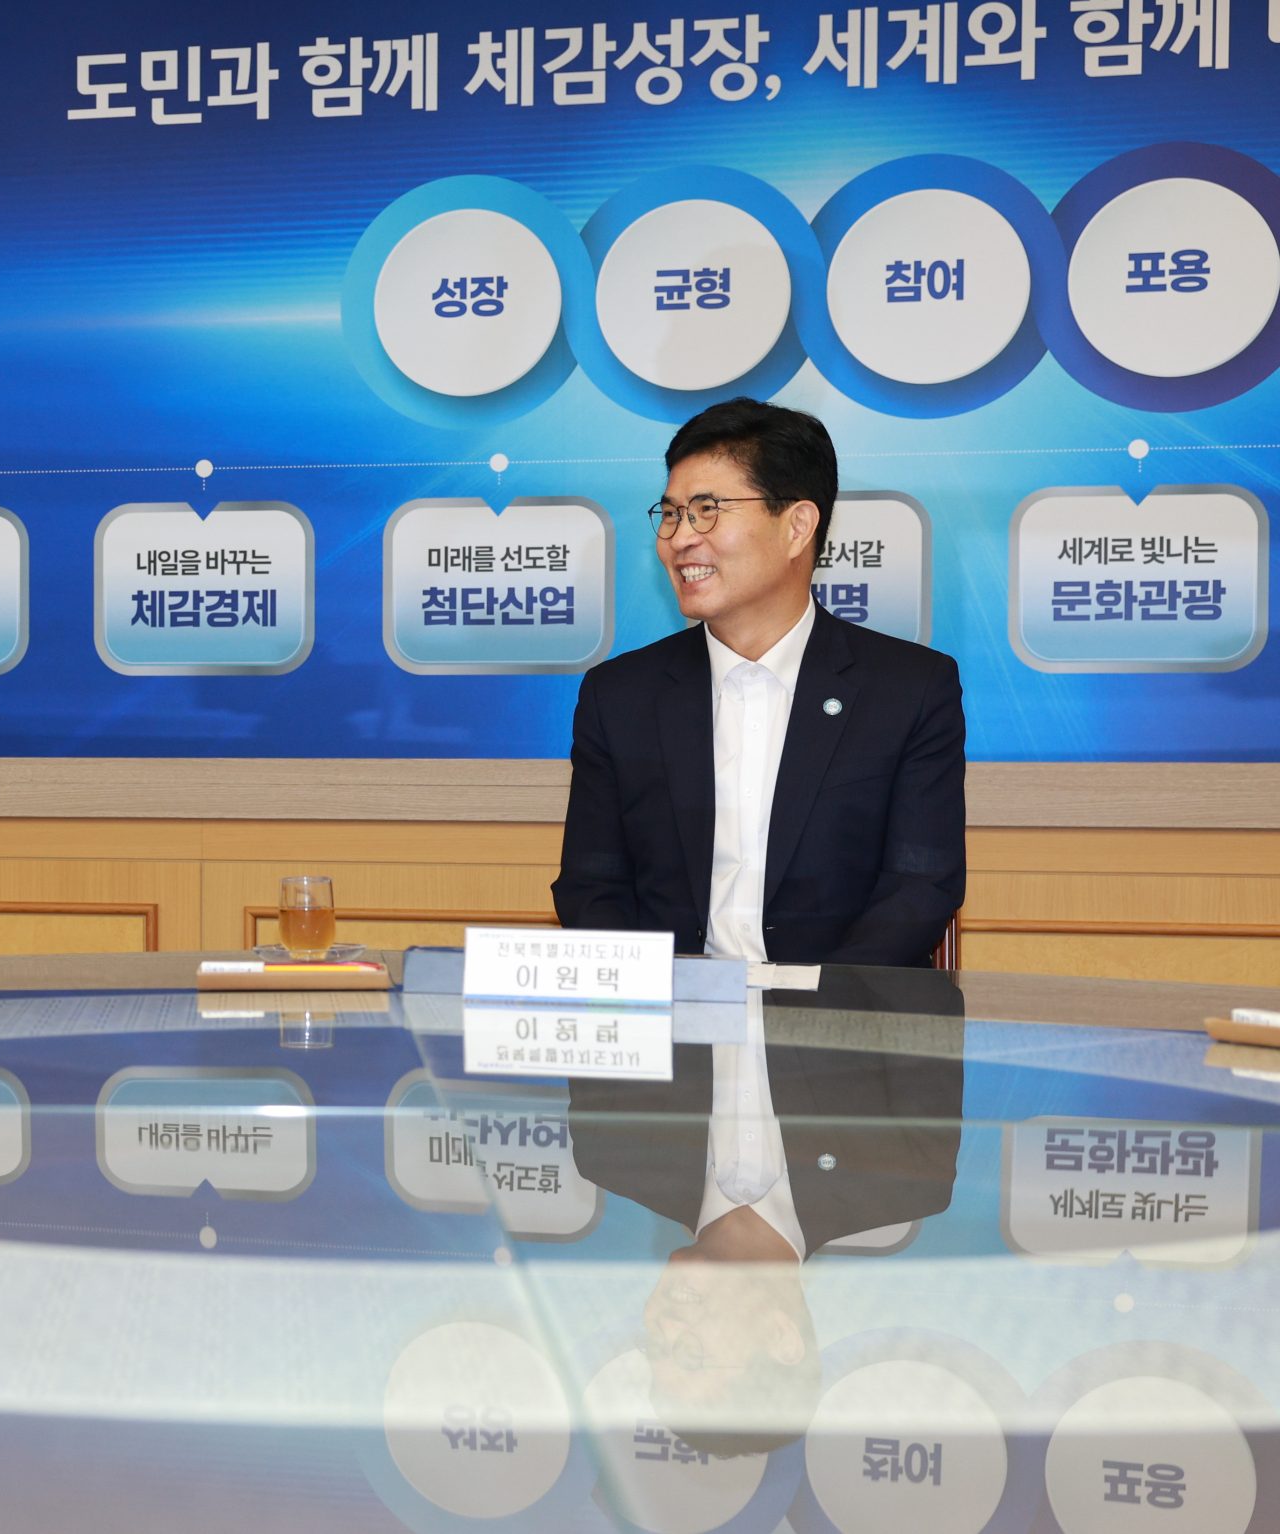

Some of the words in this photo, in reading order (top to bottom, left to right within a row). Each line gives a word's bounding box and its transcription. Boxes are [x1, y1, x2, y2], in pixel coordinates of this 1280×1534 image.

[67, 42, 279, 126] 도민과
[299, 32, 438, 118] 함께
[464, 14, 781, 108] 체감성장,
[803, 0, 1047, 89] 세계와
[1070, 0, 1230, 78] 함께
[654, 267, 731, 311] 균형
[885, 258, 965, 303] 참여
[1125, 249, 1211, 294] 포용
[431, 275, 509, 318] 성장
[136, 549, 202, 577] 내일을
[206, 549, 272, 576] 바꾸는
[428, 545, 496, 573] 미래를
[500, 544, 570, 572] 선도할
[1058, 536, 1135, 566] 세계로
[1141, 535, 1218, 565] 빛나는
[130, 589, 277, 628] 체감경제
[421, 586, 575, 626] 첨단산업
[1051, 579, 1227, 622] 문화관광
